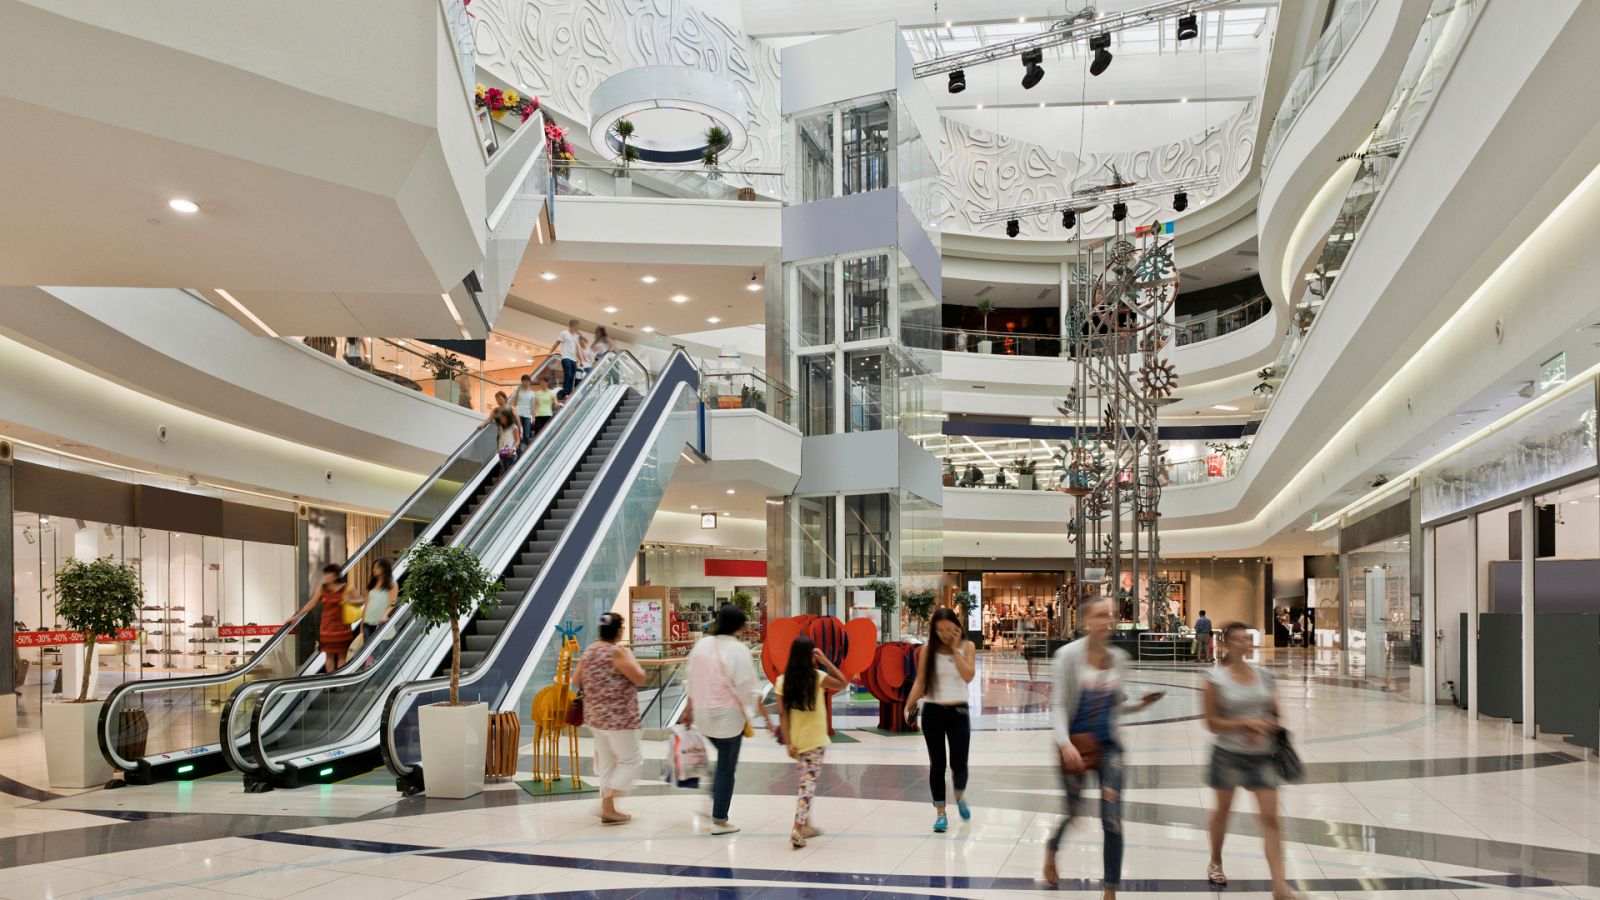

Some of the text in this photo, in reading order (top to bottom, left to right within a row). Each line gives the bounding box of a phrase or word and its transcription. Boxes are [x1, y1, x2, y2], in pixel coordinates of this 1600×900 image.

[16, 634, 32, 644] -50%
[35, 633, 51, 643] -30%
[52, 632, 68, 642] -40%
